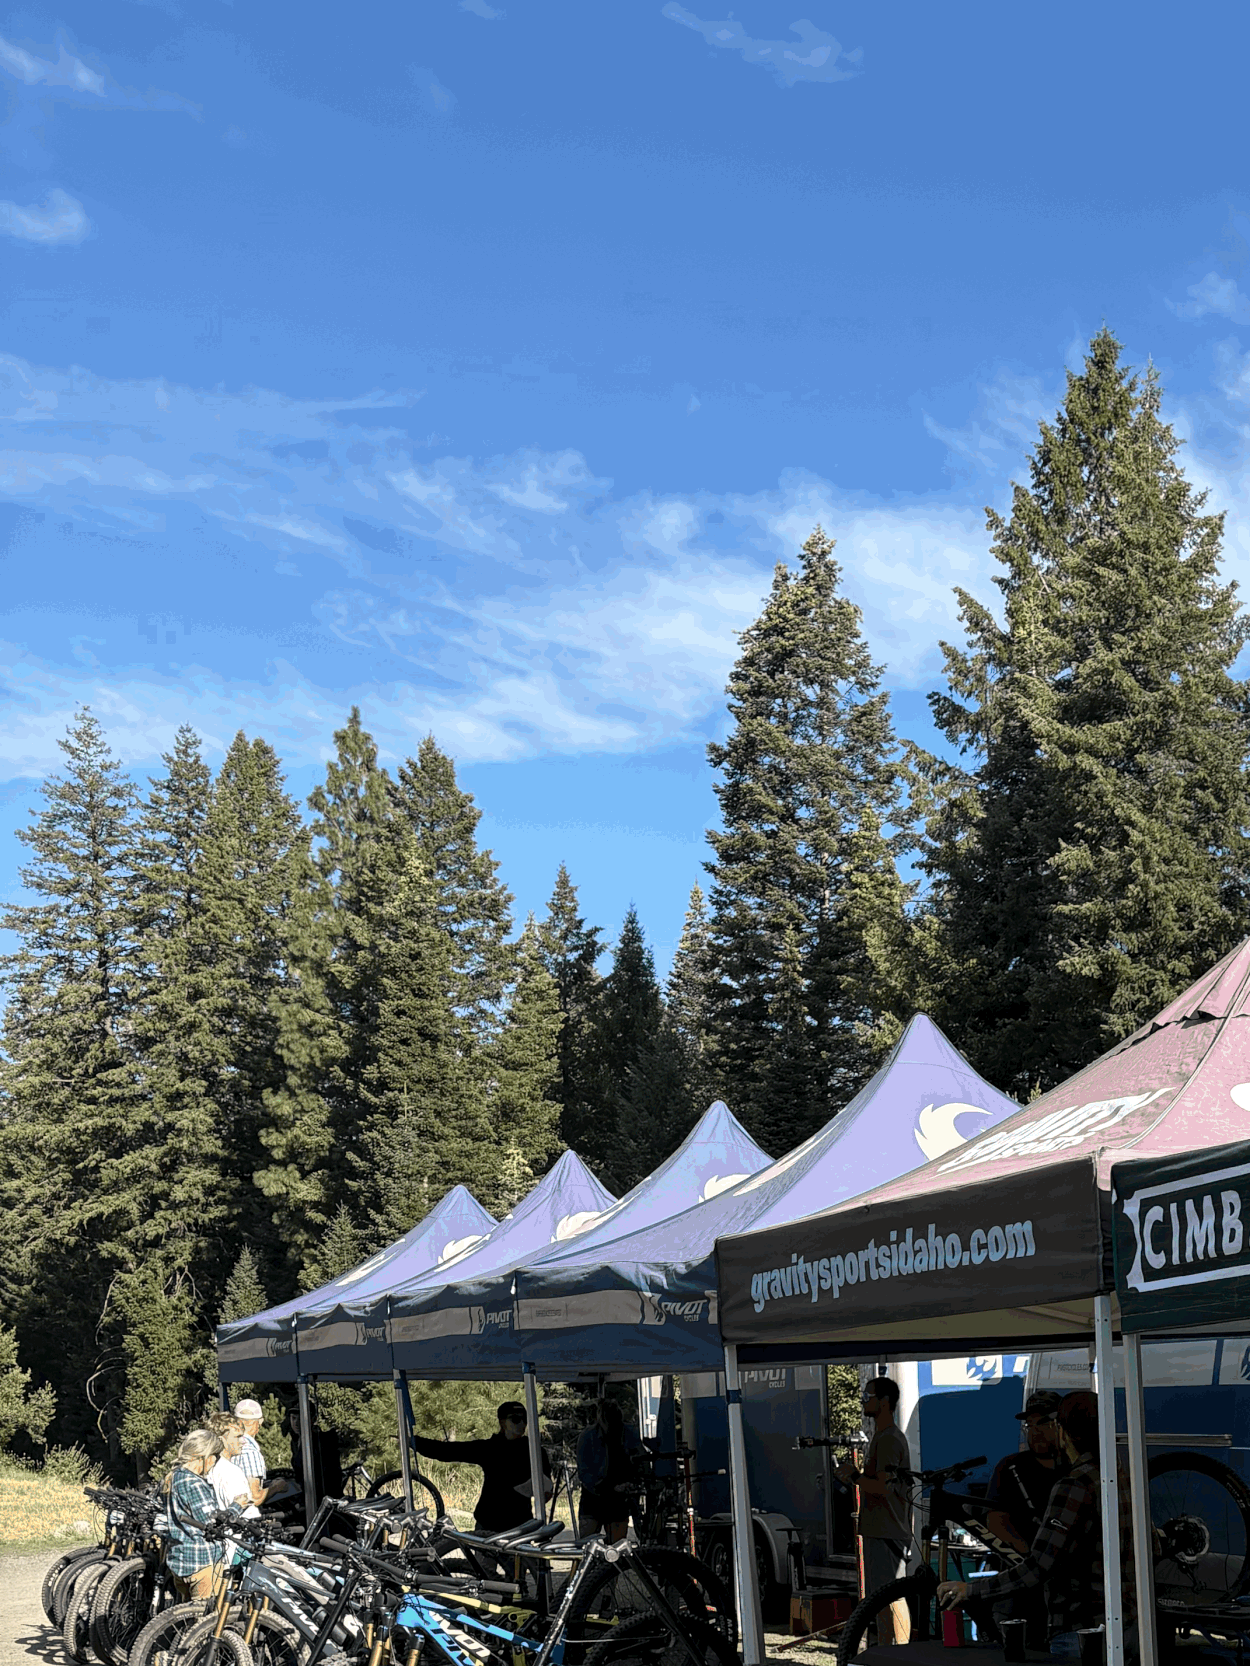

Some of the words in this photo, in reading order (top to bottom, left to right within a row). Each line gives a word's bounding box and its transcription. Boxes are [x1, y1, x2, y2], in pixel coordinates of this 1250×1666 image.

[751, 1220, 1036, 1313] gravitysportsidaho.com
[486, 1309, 513, 1325] PIVOT
[661, 1298, 708, 1316] PIVOT
[963, 1518, 1026, 1565] PIVO
